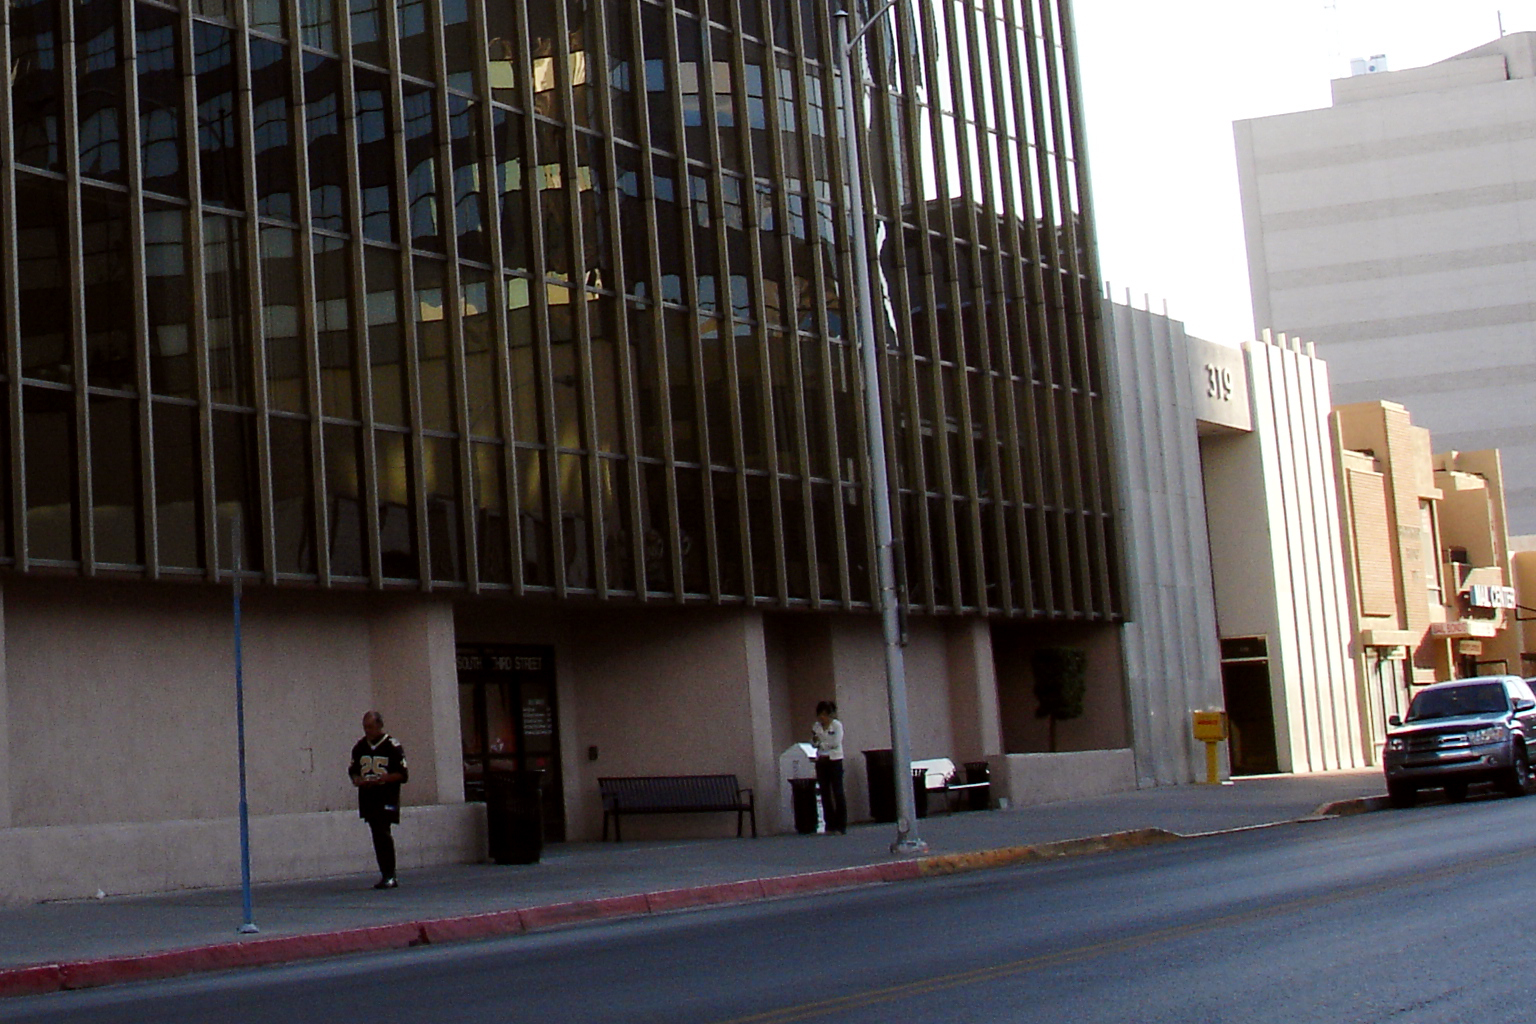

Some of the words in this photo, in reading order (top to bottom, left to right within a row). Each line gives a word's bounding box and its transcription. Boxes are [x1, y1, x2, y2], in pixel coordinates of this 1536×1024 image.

[1205, 363, 1233, 402] 319
[456, 656, 483, 670] SOUTH
[514, 656, 542, 670] STREET
[359, 755, 389, 779] 25
